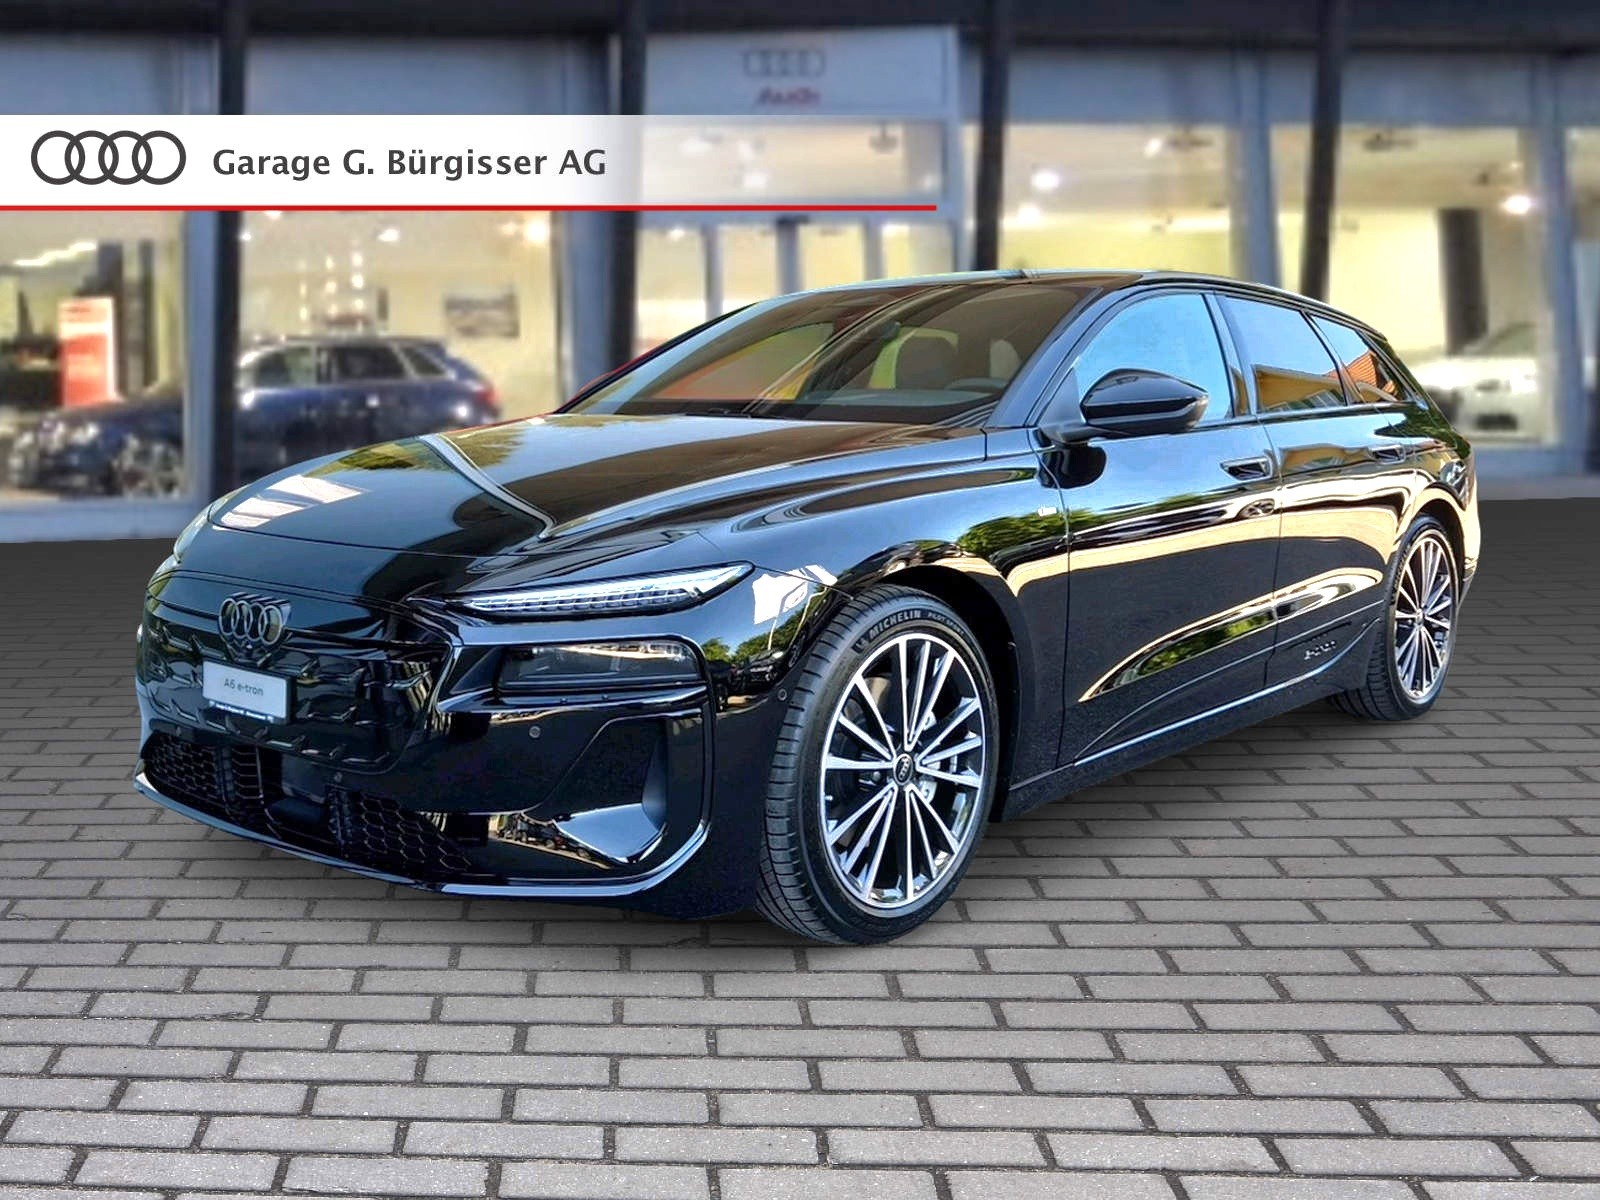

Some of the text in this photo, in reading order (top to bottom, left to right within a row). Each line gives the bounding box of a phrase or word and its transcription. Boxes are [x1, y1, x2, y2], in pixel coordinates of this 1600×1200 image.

[869, 610, 921, 639] MICHELIN
[224, 678, 264, 697] A6 e-tron
